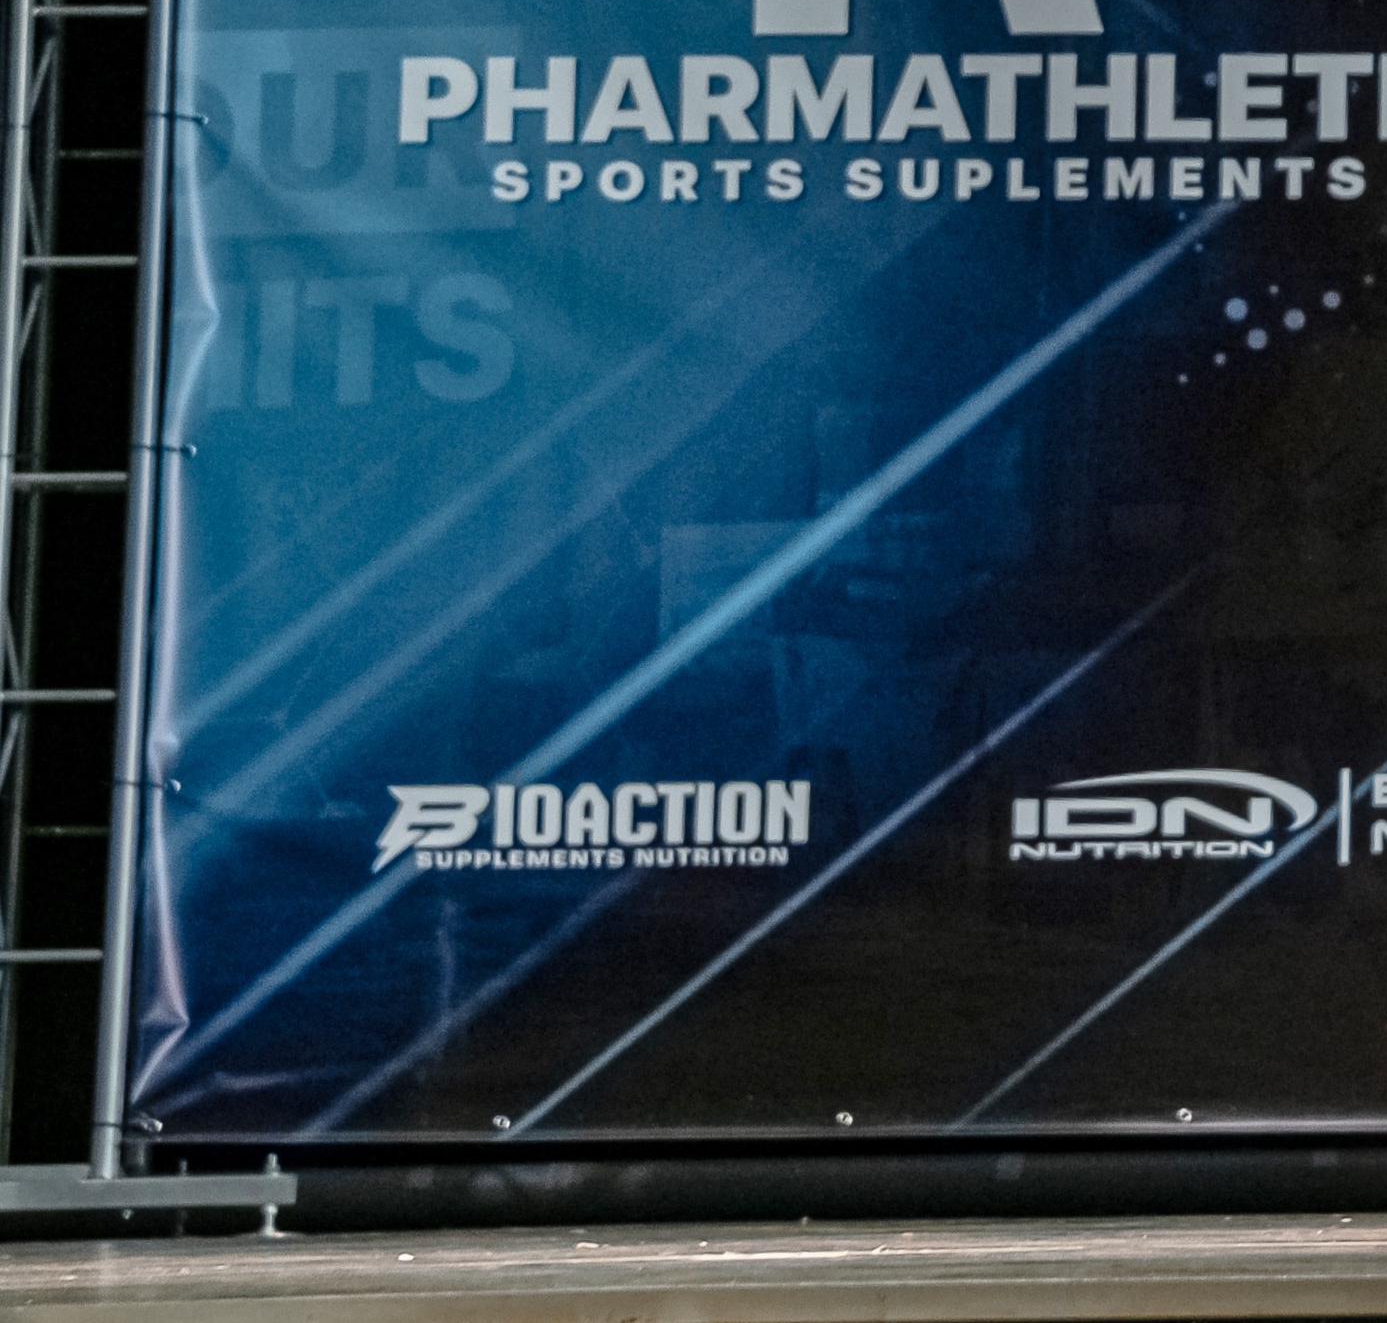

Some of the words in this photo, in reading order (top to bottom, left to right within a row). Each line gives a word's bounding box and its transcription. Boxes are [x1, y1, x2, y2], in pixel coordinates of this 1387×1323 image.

[492, 158, 804, 203] SPORTS
[846, 156, 1367, 200] SUPLEMENTS
[373, 780, 811, 873] BIOACTION
[1012, 797, 1275, 838] IDN
[415, 848, 625, 869] SUPPLEMENTS
[634, 846, 789, 867] NUTRITION
[1009, 839, 1275, 861] NUTRITION
